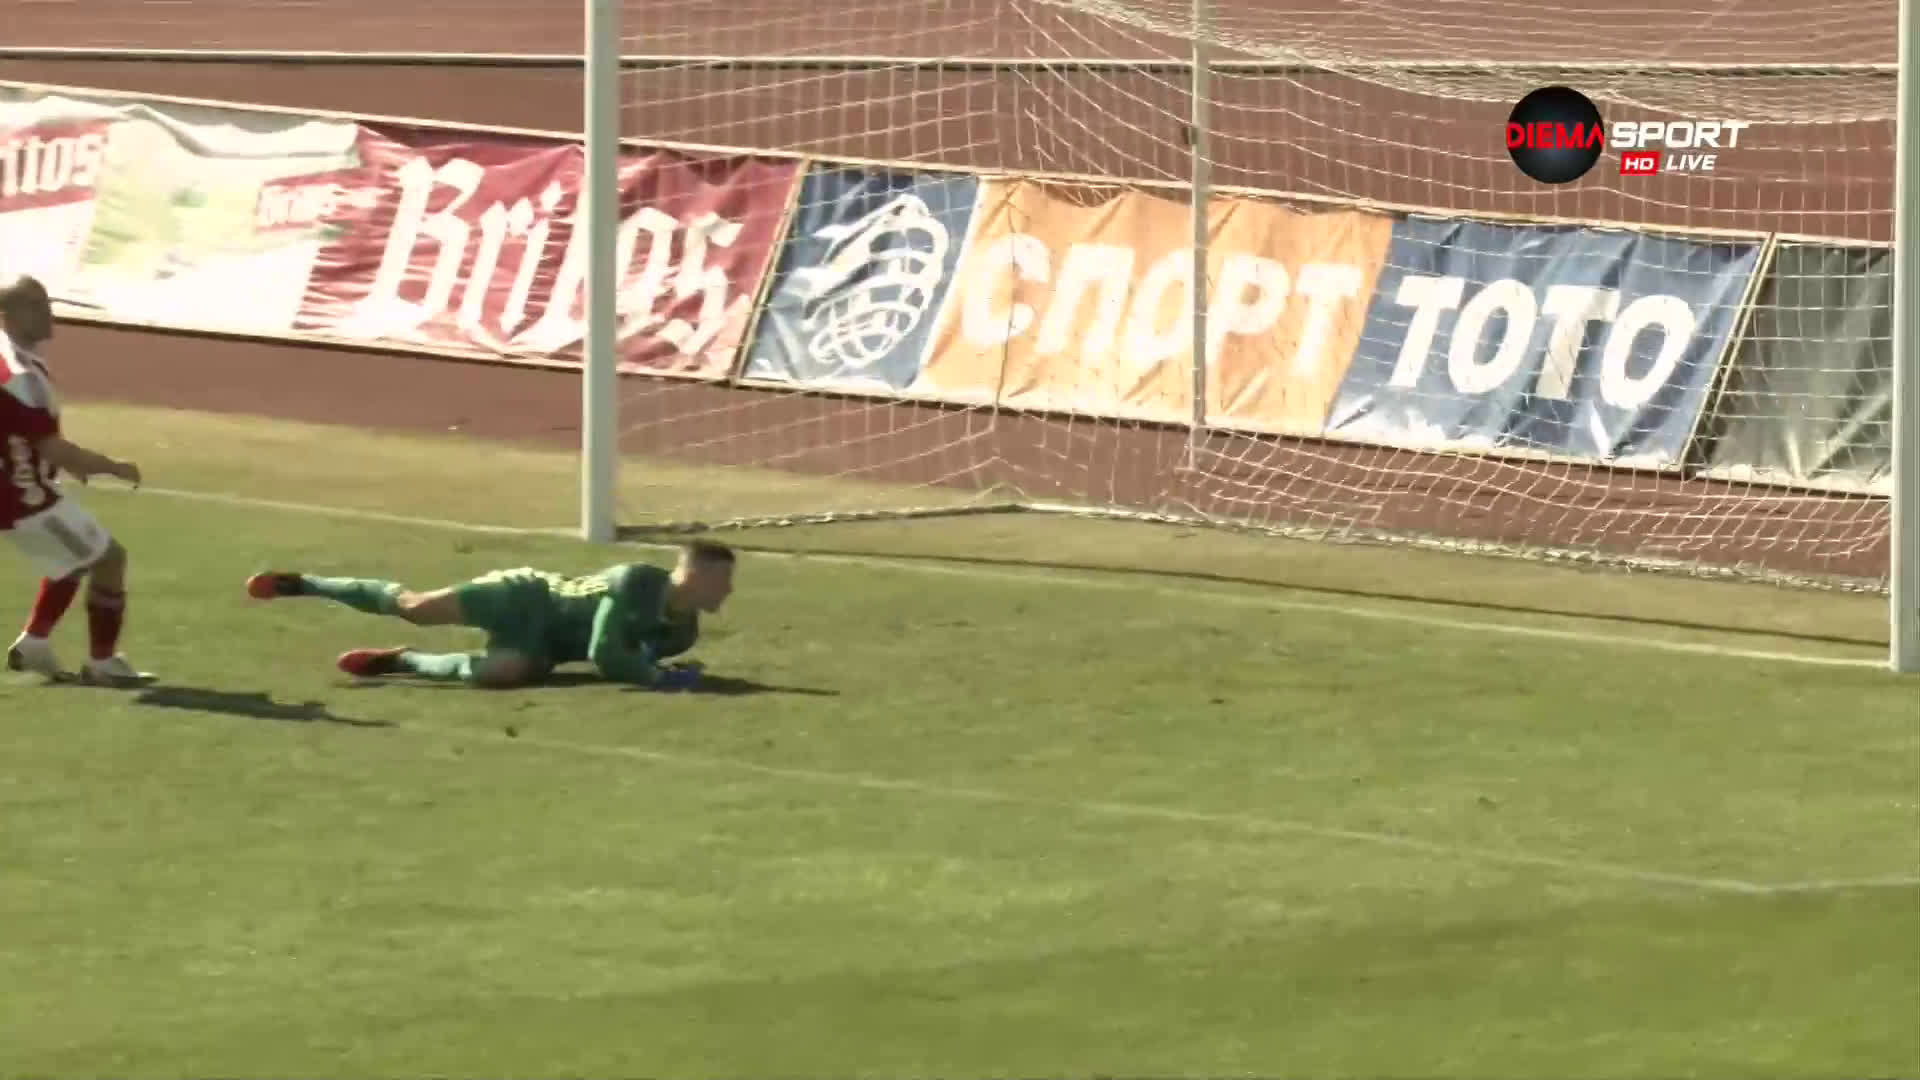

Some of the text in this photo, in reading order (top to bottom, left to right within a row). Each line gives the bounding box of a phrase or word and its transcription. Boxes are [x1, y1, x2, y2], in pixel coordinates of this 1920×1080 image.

[0, 134, 102, 197] itos
[960, 232, 1697, 409] СПОРТ ТОТО
